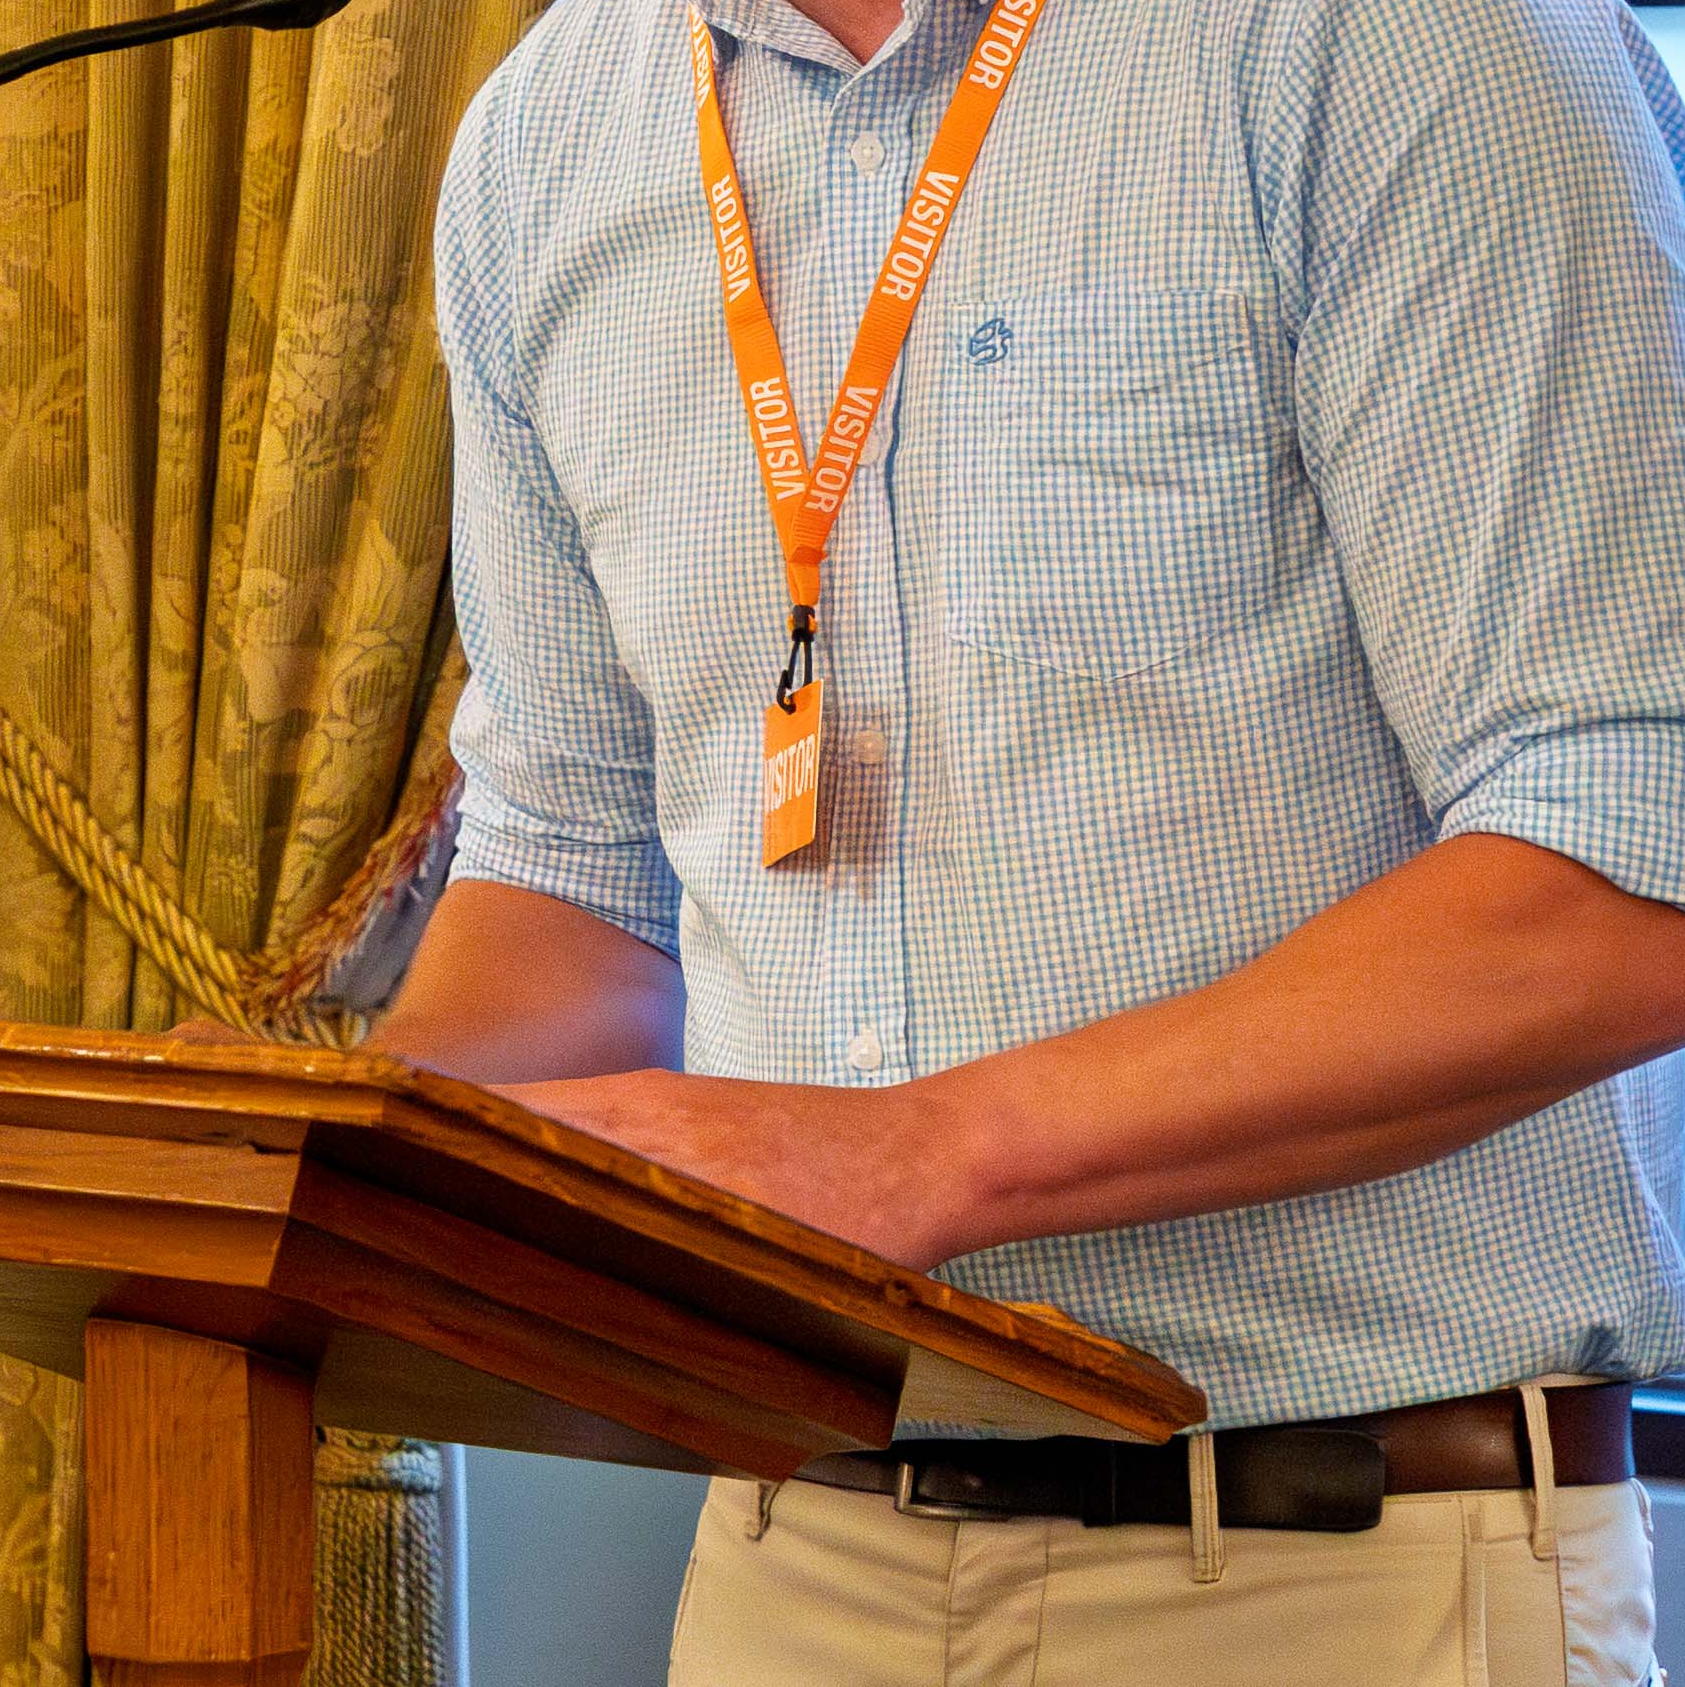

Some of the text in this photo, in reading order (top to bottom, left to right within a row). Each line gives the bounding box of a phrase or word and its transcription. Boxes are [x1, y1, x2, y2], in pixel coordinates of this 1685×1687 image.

[692, 8, 711, 109] VISITO
[711, 173, 751, 303] VISITOR
[881, 171, 960, 302] VISITOR
[750, 376, 807, 501] VISITOR
[805, 386, 879, 513] VISITOR
[765, 732, 816, 813] VISITOR
